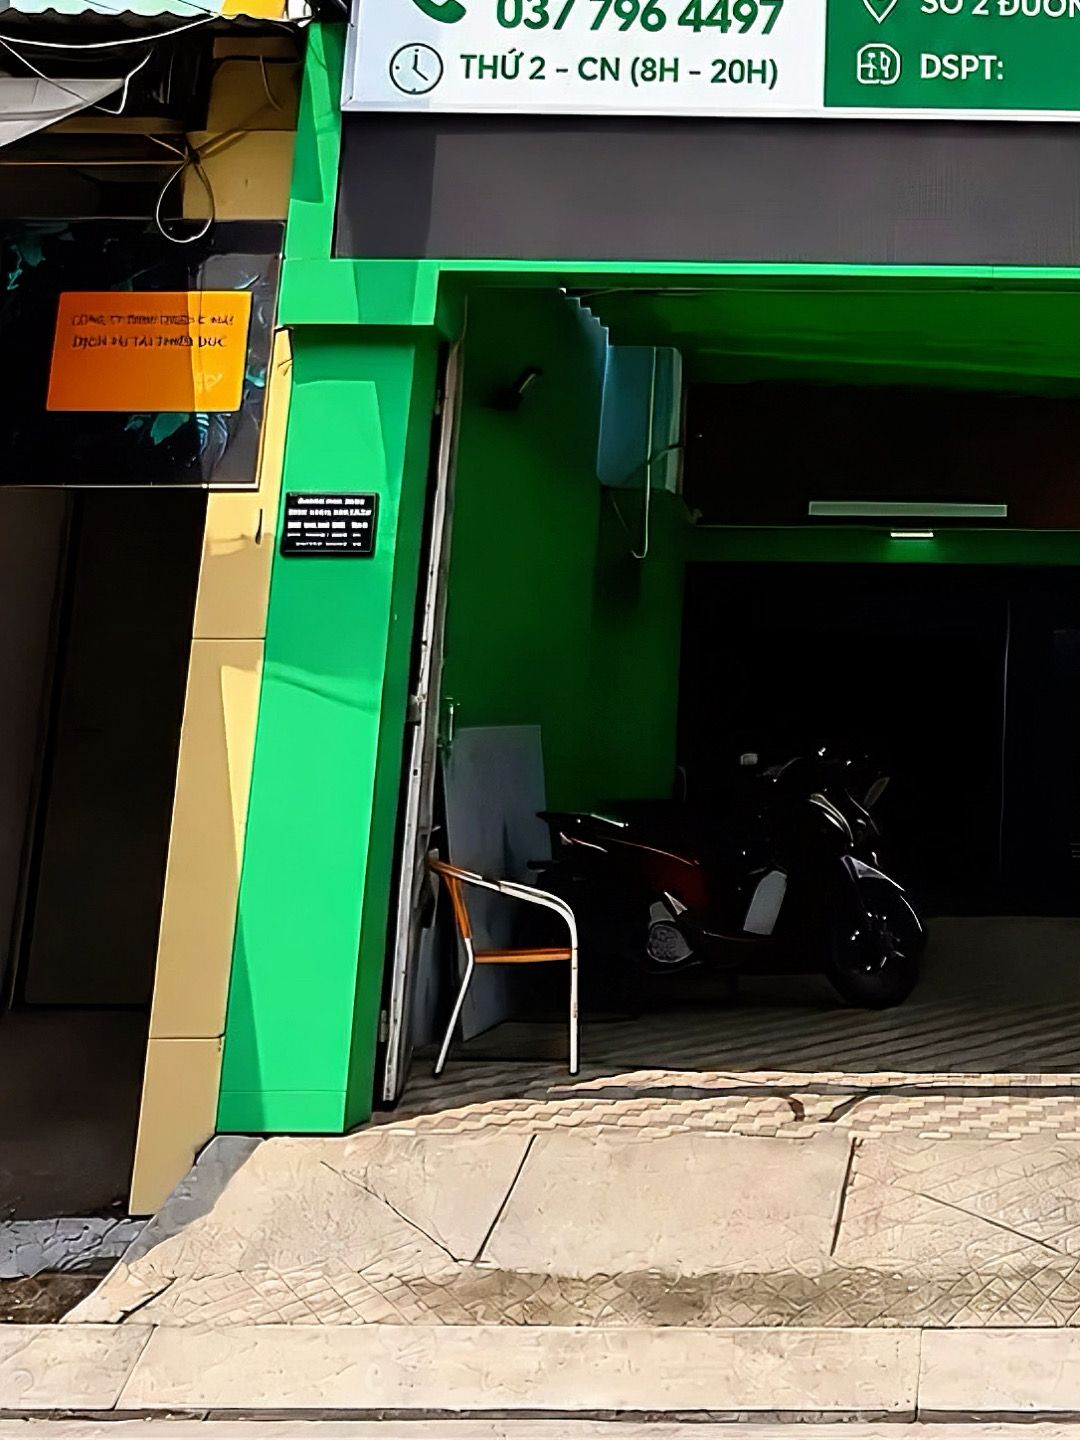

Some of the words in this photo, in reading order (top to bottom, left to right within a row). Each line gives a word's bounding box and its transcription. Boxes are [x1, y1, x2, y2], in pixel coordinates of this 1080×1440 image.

[460, 48, 525, 80] THỨ
[528, 56, 546, 80] 2
[577, 57, 621, 82] CN
[631, 57, 679, 88] (8H
[710, 58, 778, 91] 20H)
[920, 54, 1003, 80] DSPT:
